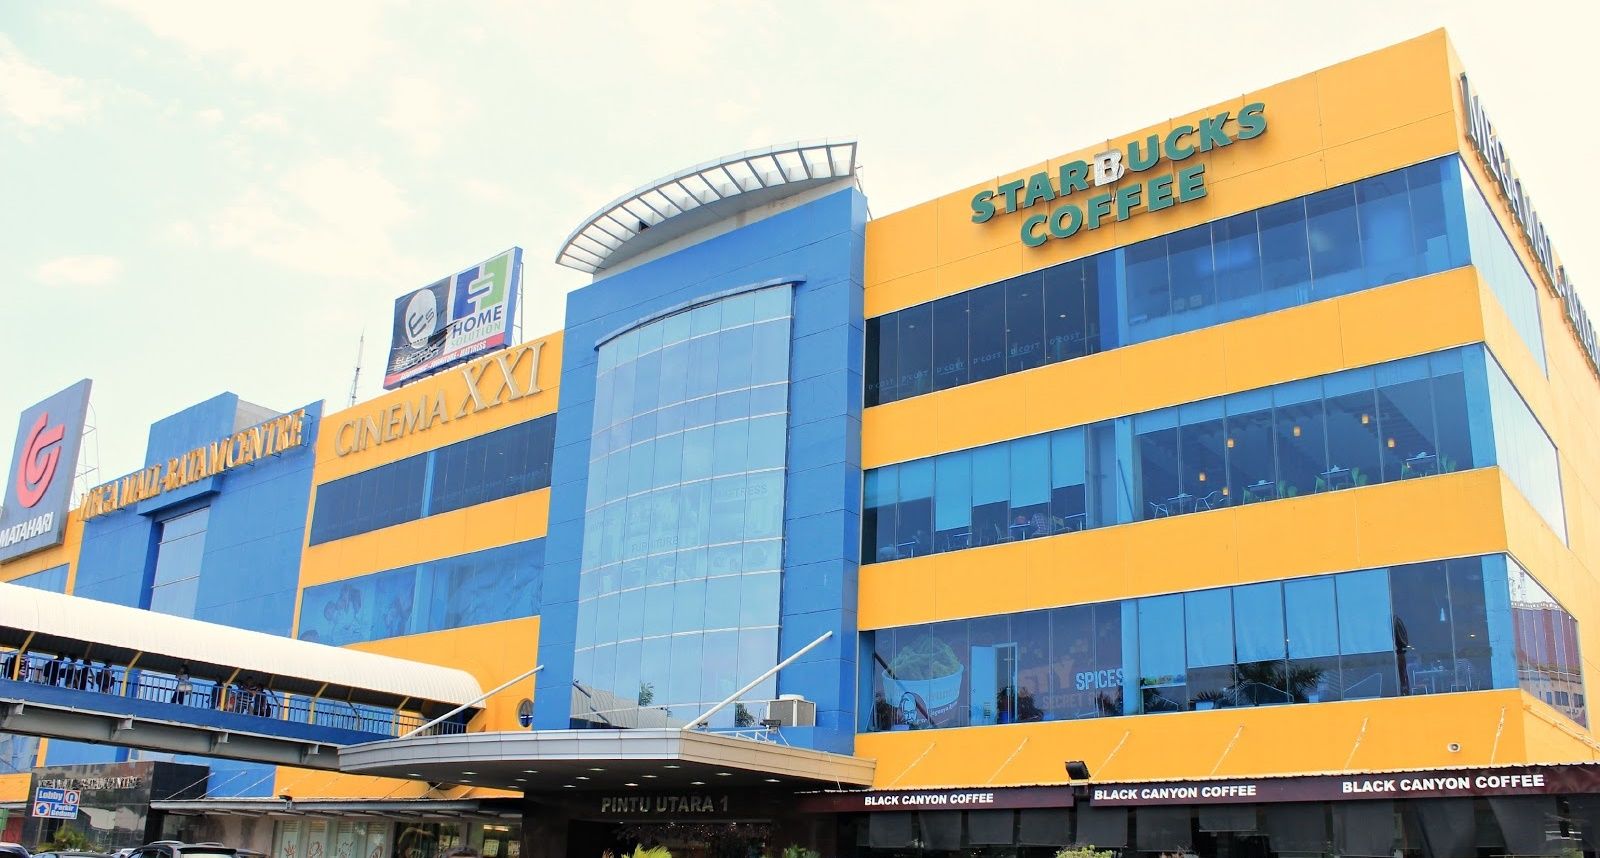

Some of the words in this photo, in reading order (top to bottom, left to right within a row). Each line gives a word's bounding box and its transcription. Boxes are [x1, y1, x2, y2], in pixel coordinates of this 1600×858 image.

[970, 102, 1268, 224] STARBUCKS
[1020, 163, 1208, 248] COFFEE
[452, 304, 502, 339] HOME
[450, 321, 502, 348] SOLUTION
[335, 389, 449, 457] CINEMA
[455, 341, 547, 421] XXI
[0, 511, 54, 548] MATAHARI
[1075, 668, 1124, 691] SPICES
[39, 790, 63, 801] Lobby
[1094, 787, 1138, 801] BLACK
[1141, 787, 1198, 800] CANYON
[1201, 785, 1257, 798] COFFEE
[1342, 779, 1396, 794] BLACK
[1400, 777, 1470, 792] CANYON
[1475, 774, 1545, 789] COFFEE
[601, 797, 651, 813] PINTU
[656, 796, 714, 813] UTARA
[720, 795, 728, 813] 1
[864, 795, 899, 806] BLACK
[901, 795, 947, 806] CANYON
[950, 793, 994, 804] COFFEE
